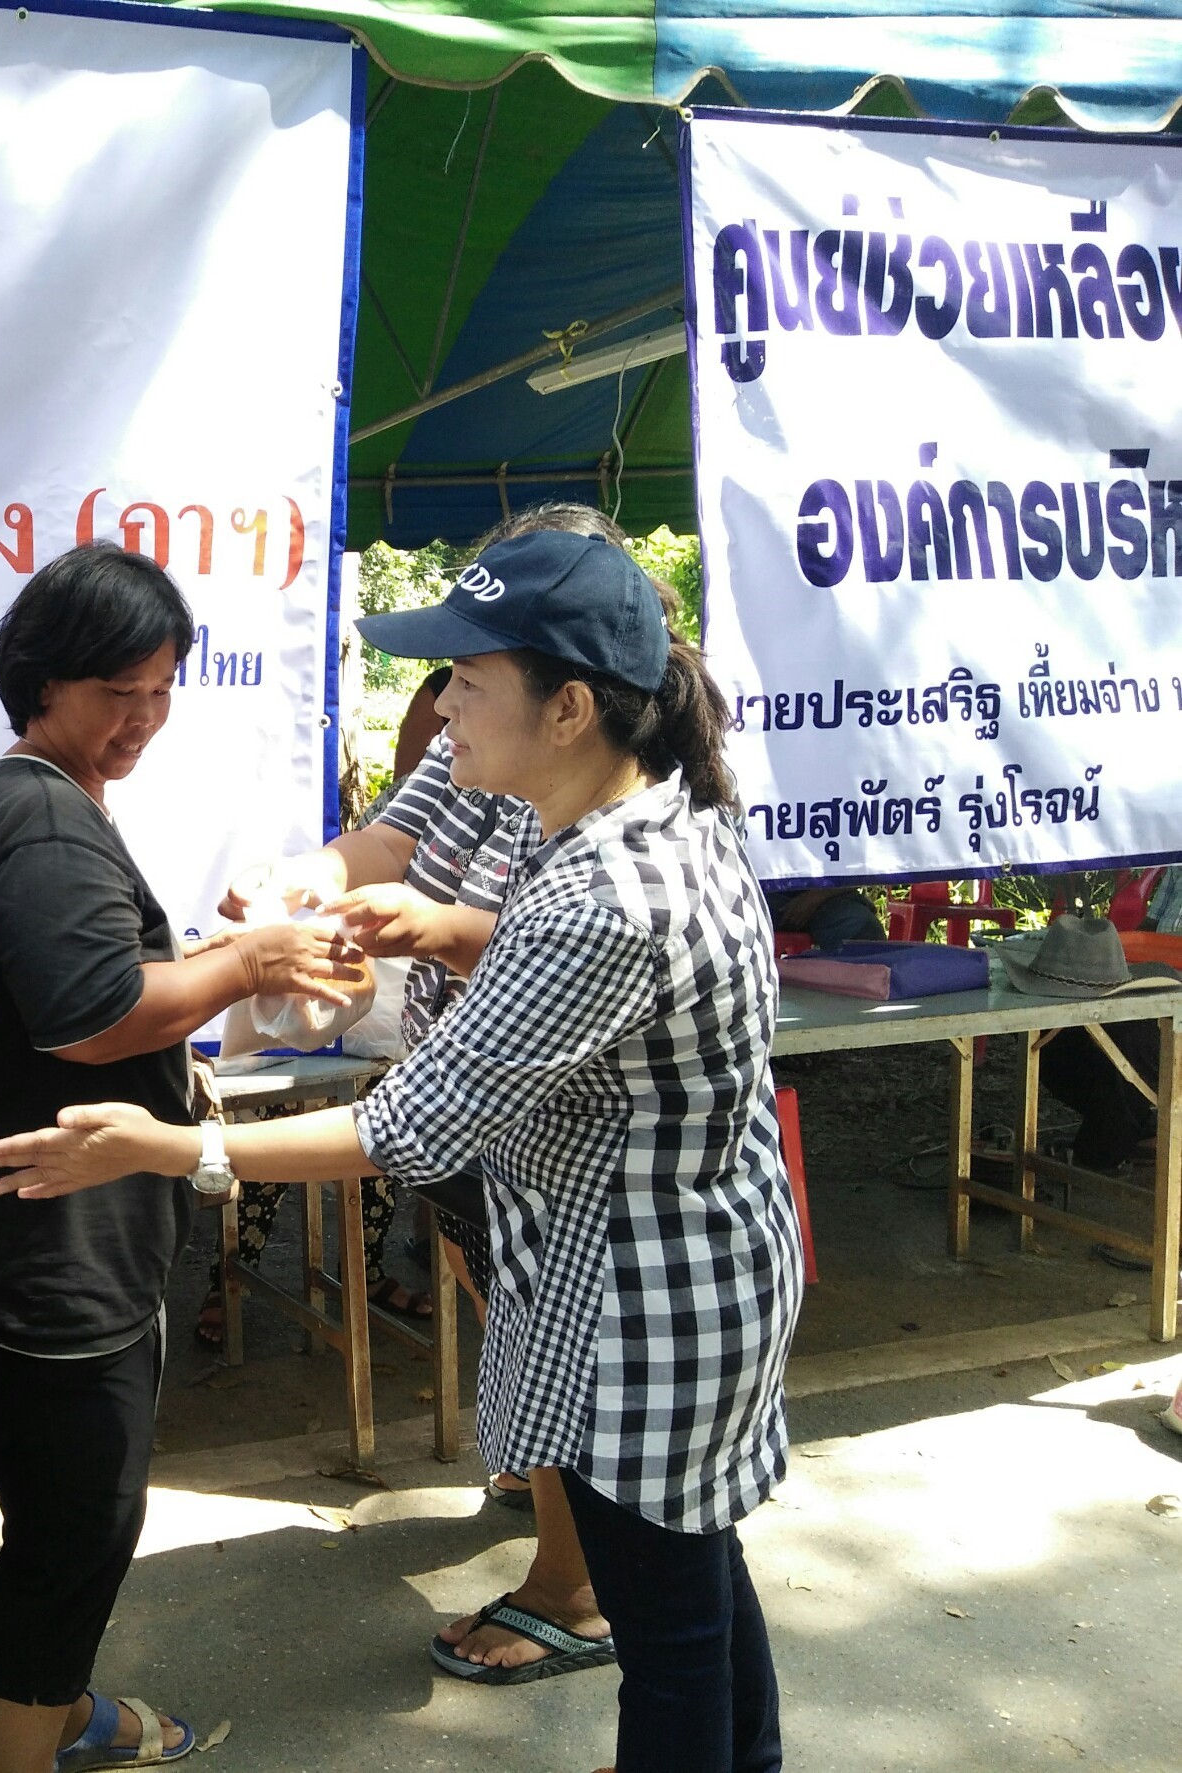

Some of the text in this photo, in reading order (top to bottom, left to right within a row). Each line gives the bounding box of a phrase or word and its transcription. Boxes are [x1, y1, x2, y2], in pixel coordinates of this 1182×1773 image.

[743, 763, 1104, 862] ายสุพัตร์ รุ่งโรจน์
